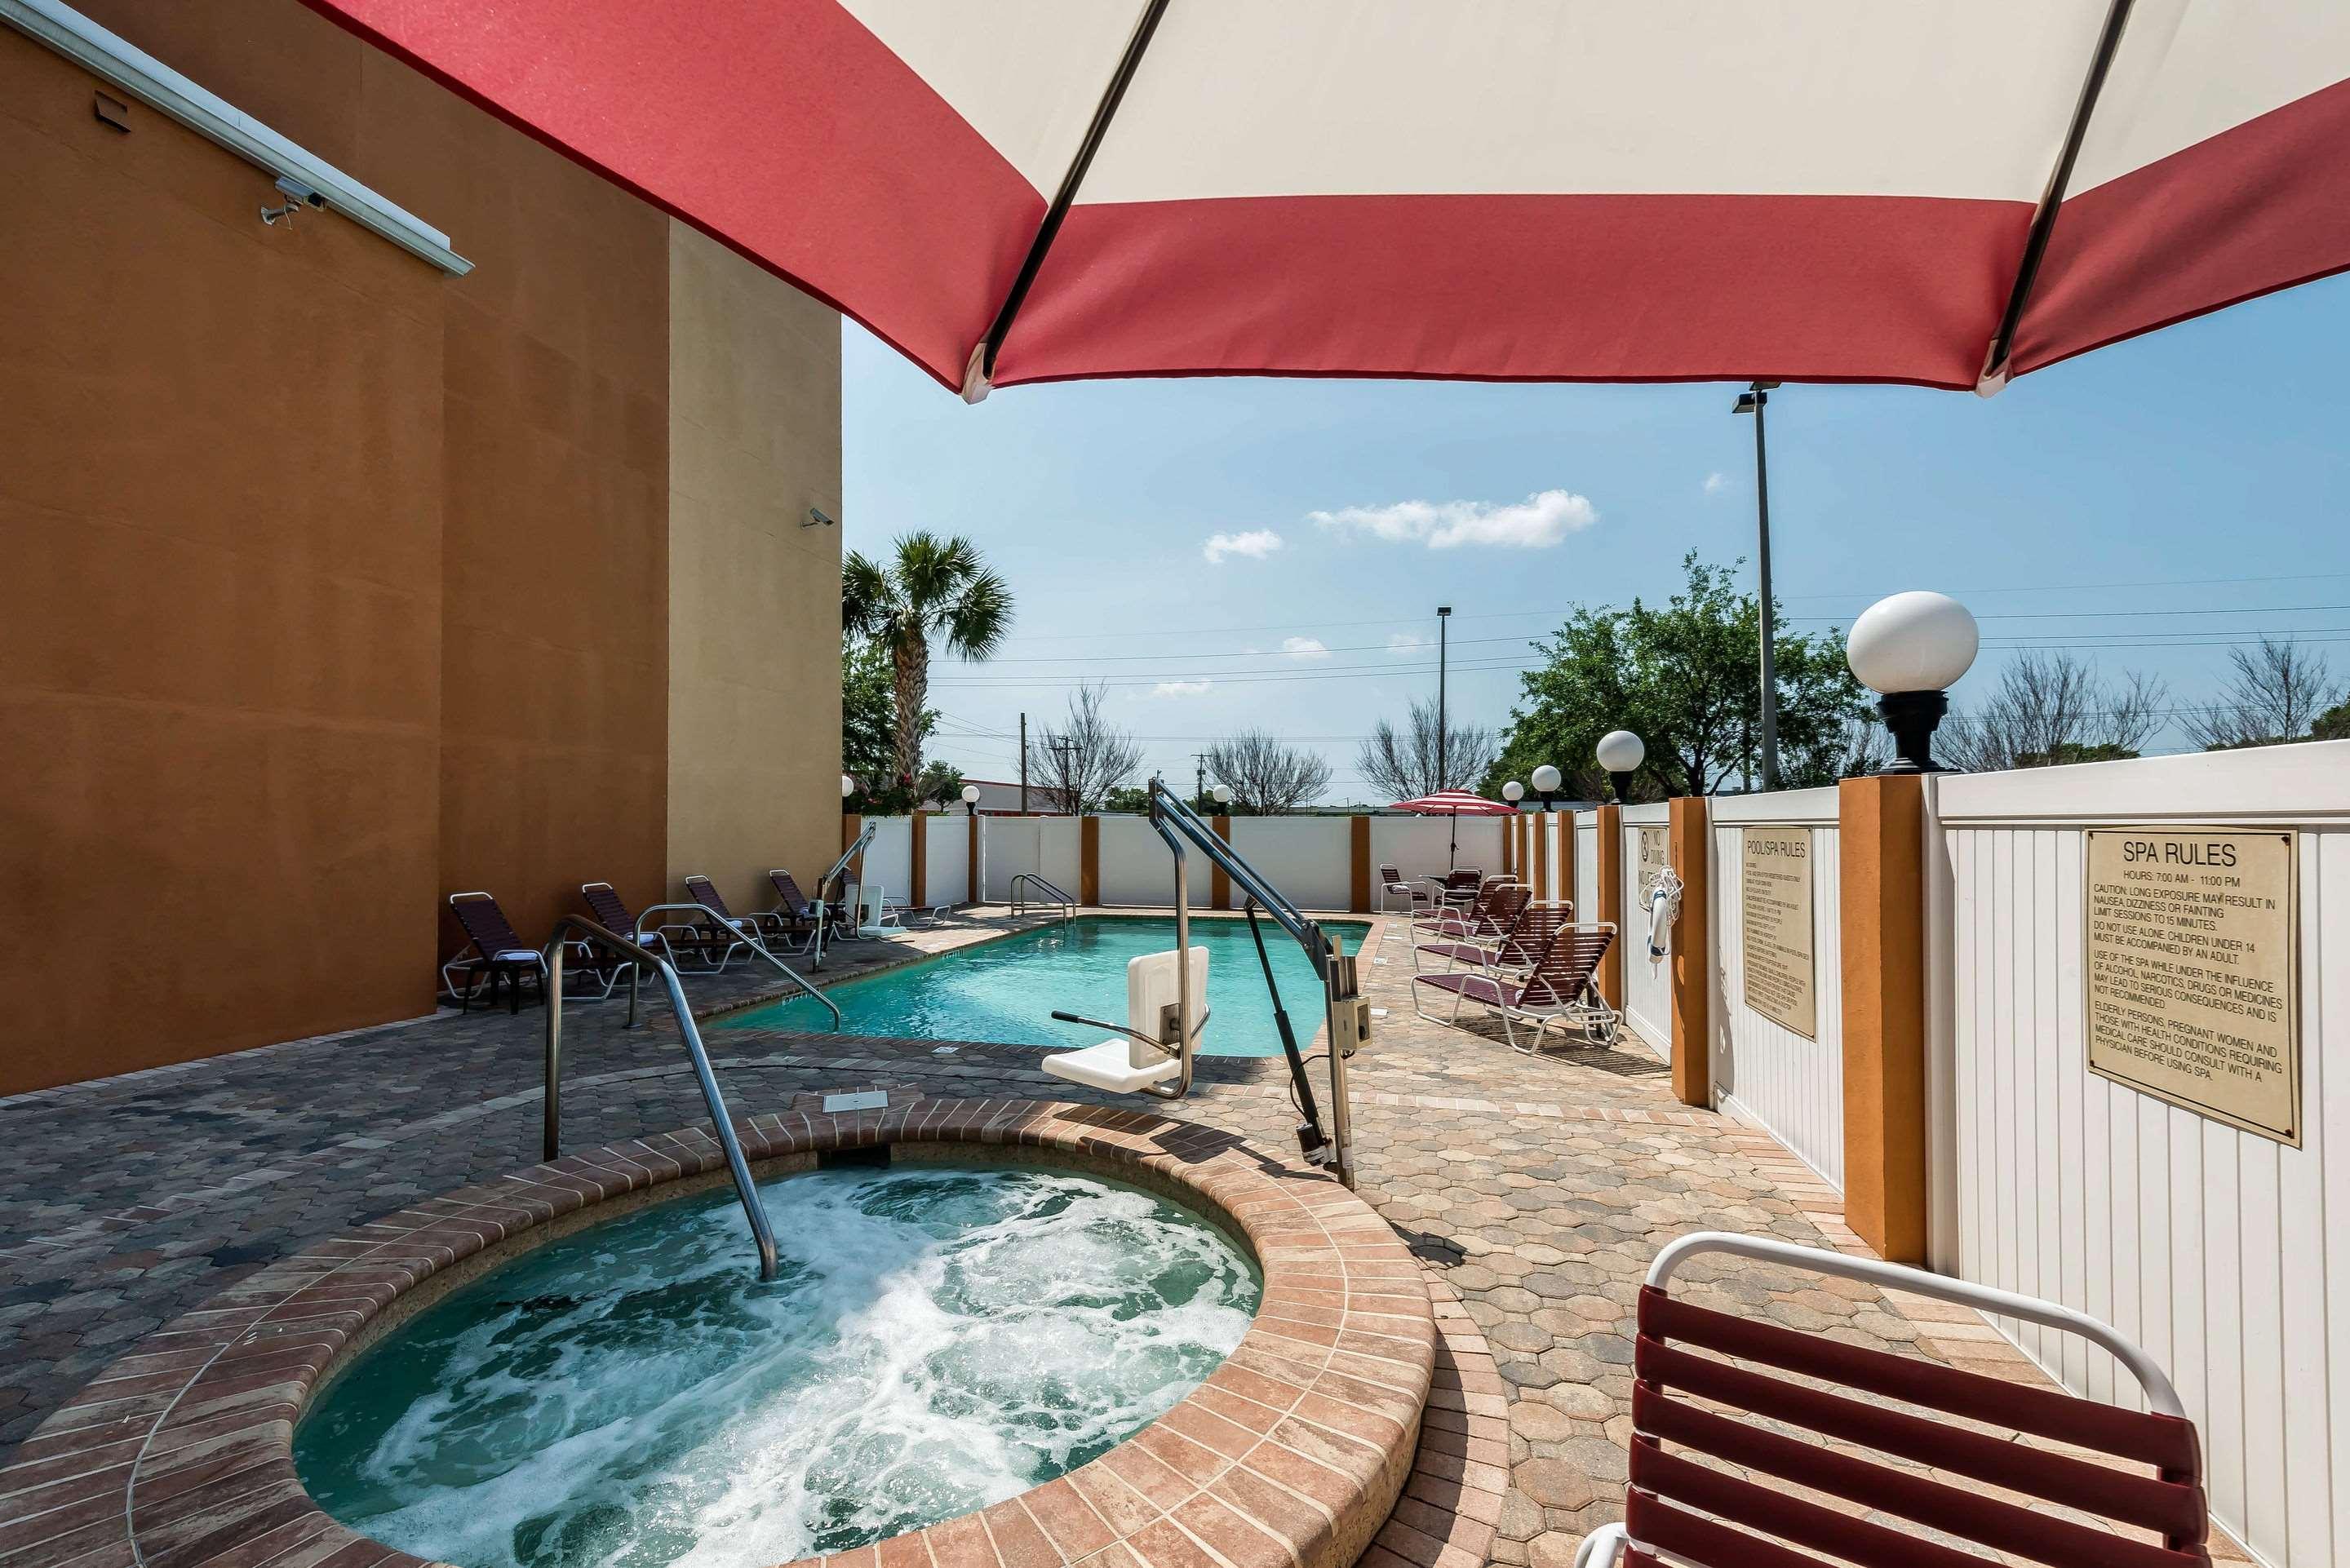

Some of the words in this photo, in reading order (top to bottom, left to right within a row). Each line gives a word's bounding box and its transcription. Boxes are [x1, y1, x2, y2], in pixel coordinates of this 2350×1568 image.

[1748, 840, 1778, 856] POOL/SPA
[1780, 841, 1806, 858] RULES
[2123, 841, 2158, 862] SPA
[2166, 843, 2237, 866] RULES
[2157, 873, 2172, 883] 7:00
[2175, 874, 2188, 883] AM
[2201, 876, 2222, 886] 11:00
[2224, 877, 2240, 887] PM
[2094, 884, 2126, 895] CAUTION:
[2130, 888, 2150, 897] LONG
[2153, 889, 2200, 902] EXPOSURE
[2203, 893, 2222, 904] MAY
[2225, 896, 2262, 908] RESULT
[2266, 899, 2276, 910] IN
[2126, 899, 2166, 911] DIZZINESS
[2168, 903, 2180, 913] OR
[2184, 905, 2224, 918] FAINTING
[2094, 907, 2112, 916] LIMIT
[2114, 910, 2151, 922] SESSIONS
[2154, 914, 2164, 924] TO
[2166, 916, 2174, 925] 15
[2177, 917, 2217, 931] MINUTES.
[2094, 921, 2104, 930] DO
[2107, 923, 2121, 932] NOT
[2123, 925, 2138, 935] USE
[2168, 931, 2208, 946] CHILDREN
[2211, 937, 2242, 951] UNDER
[2246, 943, 2255, 953] 14
[2094, 932, 2113, 943] MUST
[2115, 936, 2125, 945] BE
[2126, 937, 2180, 954] ACCOMPANIED
[2183, 946, 2193, 956] BY
[2196, 949, 2207, 959] AN
[2210, 951, 2239, 964] ADULT.
[2094, 950, 2108, 959] USE
[2109, 953, 2119, 961] OF
[2121, 955, 2135, 965] THE
[2136, 957, 2148, 968] SPA
[2151, 960, 2174, 972] WHILE
[2176, 964, 2203, 978] UNDER
[2206, 970, 2222, 982] THE
[2225, 974, 2273, 993] INFLUENCE
[2095, 961, 2104, 970] OF
[2188, 981, 2216, 994] DRUGS
[2219, 987, 2232, 998] OR
[2235, 990, 2282, 1009] MEDICINES
[2095, 985, 2108, 994] NOT
[2095, 972, 2108, 982] MAY
[2110, 977, 2127, 987] LEAD
[2129, 981, 2139, 990] TO
[2141, 983, 2172, 998] SERIOUS
[2175, 990, 2244, 1015] CONSEQUENCES
[2246, 1007, 2265, 1020] AND
[2268, 1011, 2277, 1022] IS
[2095, 1001, 2126, 1016] ELDERLY
[2168, 1020, 2214, 1040] PREGNANT
[2217, 1032, 2253, 1052] WOMEN
[2256, 1043, 2277, 1057] AND
[2095, 1012, 2120, 1026] THOSE
[2122, 1019, 2139, 1032] WITH
[2142, 1025, 2170, 1041] HEALTH
[2174, 1034, 2226, 1057] CONDITIONS
[2229, 1050, 2282, 1074] REQUIRING
[2095, 1024, 2126, 1040] MEDICAL
[2127, 1033, 2148, 1047] CARE
[2149, 1039, 2182, 1057] SHOULD
[2185, 1051, 2225, 1070] CONSULT
[2228, 1063, 2252, 1079] WITH
[2255, 1072, 2262, 1082] A
[2095, 1035, 2132, 1054] PHYSICIAN
[2135, 1047, 2165, 1065] BEFORE
[2167, 1057, 2192, 1074] USING
